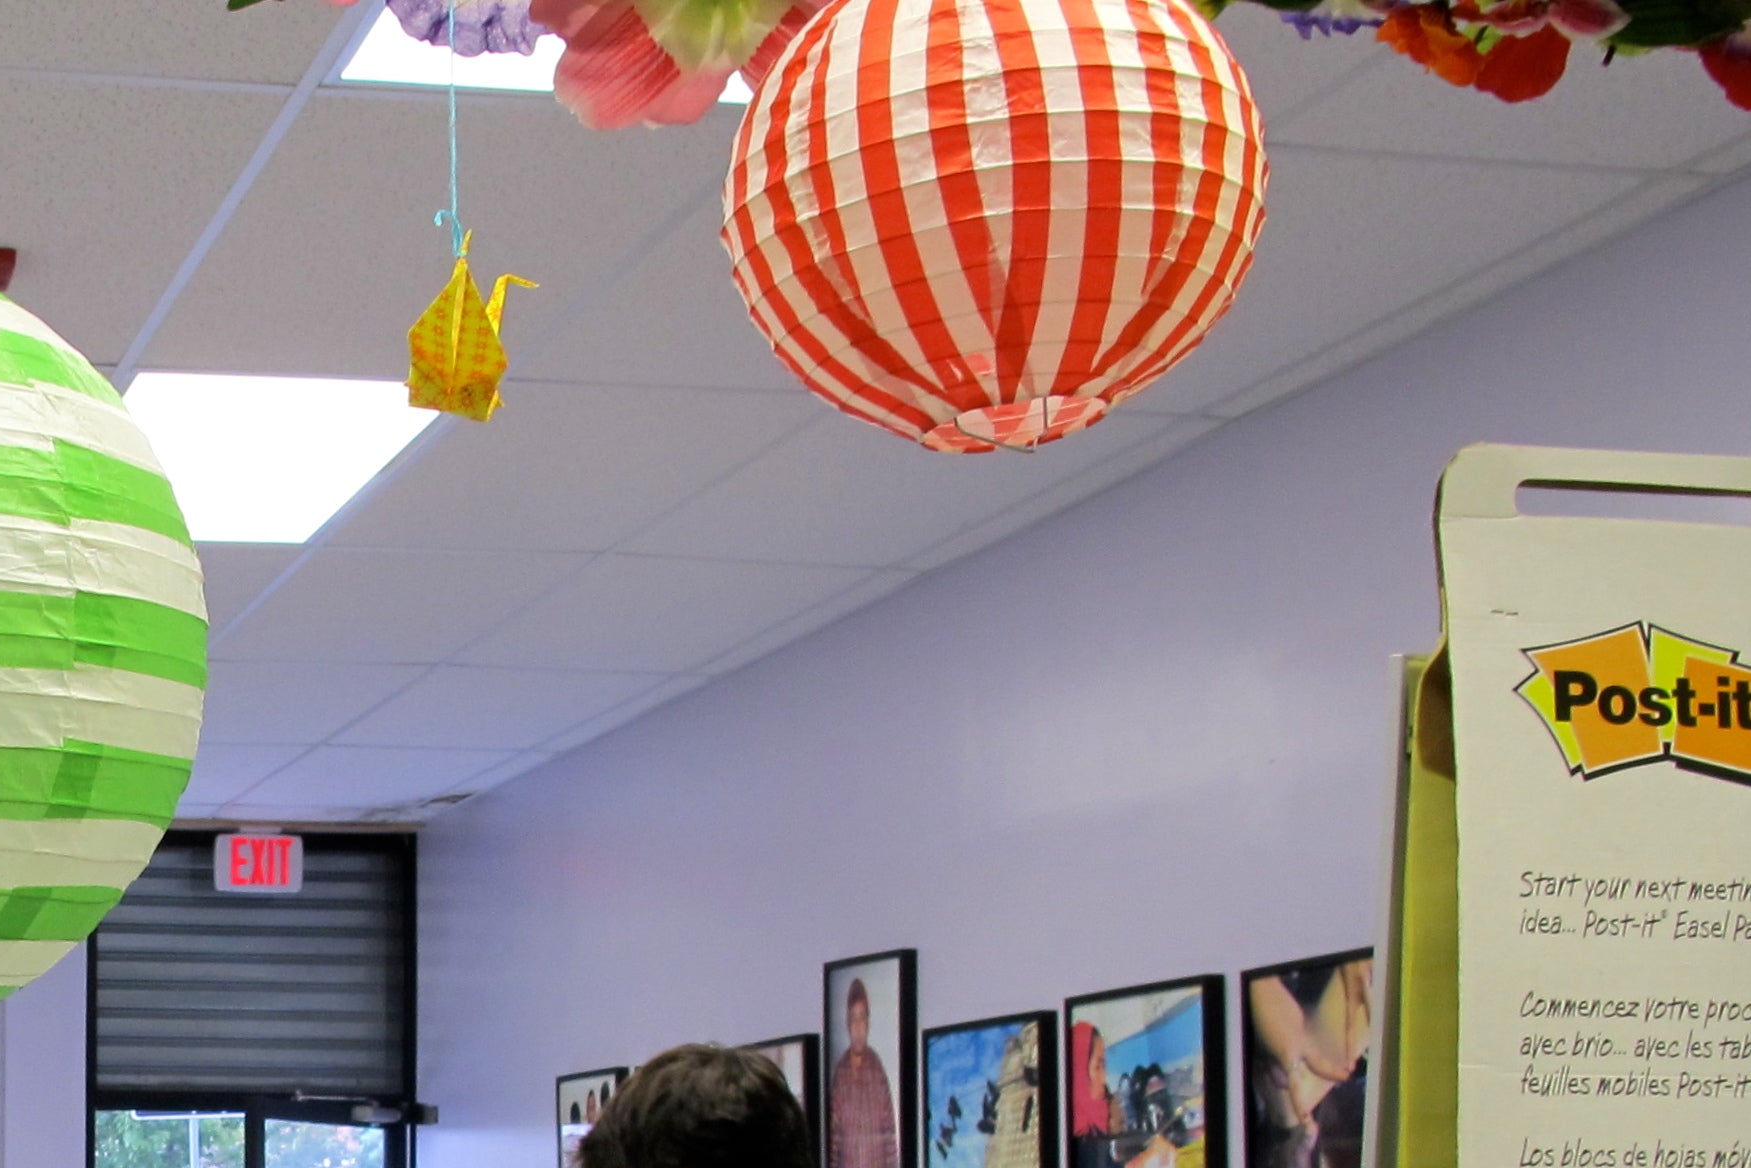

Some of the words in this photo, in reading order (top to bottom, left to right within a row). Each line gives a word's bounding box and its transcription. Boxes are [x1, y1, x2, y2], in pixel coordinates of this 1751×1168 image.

[1554, 669, 1751, 730] Post-it
[230, 837, 293, 886] EXIT
[1519, 871, 1582, 898] Start
[1583, 877, 1631, 908] your
[1634, 876, 1687, 901] next
[1519, 909, 1577, 934] idea...
[1673, 910, 1730, 940] Easel
[1519, 990, 1640, 1018] Commencez
[1644, 997, 1699, 1022] votre
[1519, 1033, 1567, 1058] avec
[1571, 1031, 1627, 1058] brio...
[1634, 1036, 1680, 1060] avec
[1684, 1029, 1713, 1059] les
[1521, 1063, 1591, 1097] feuilles
[1597, 1067, 1670, 1097] mobiles
[1519, 1137, 1554, 1168] Los
[1560, 1138, 1616, 1168] blocs
[1623, 1142, 1646, 1168] de
